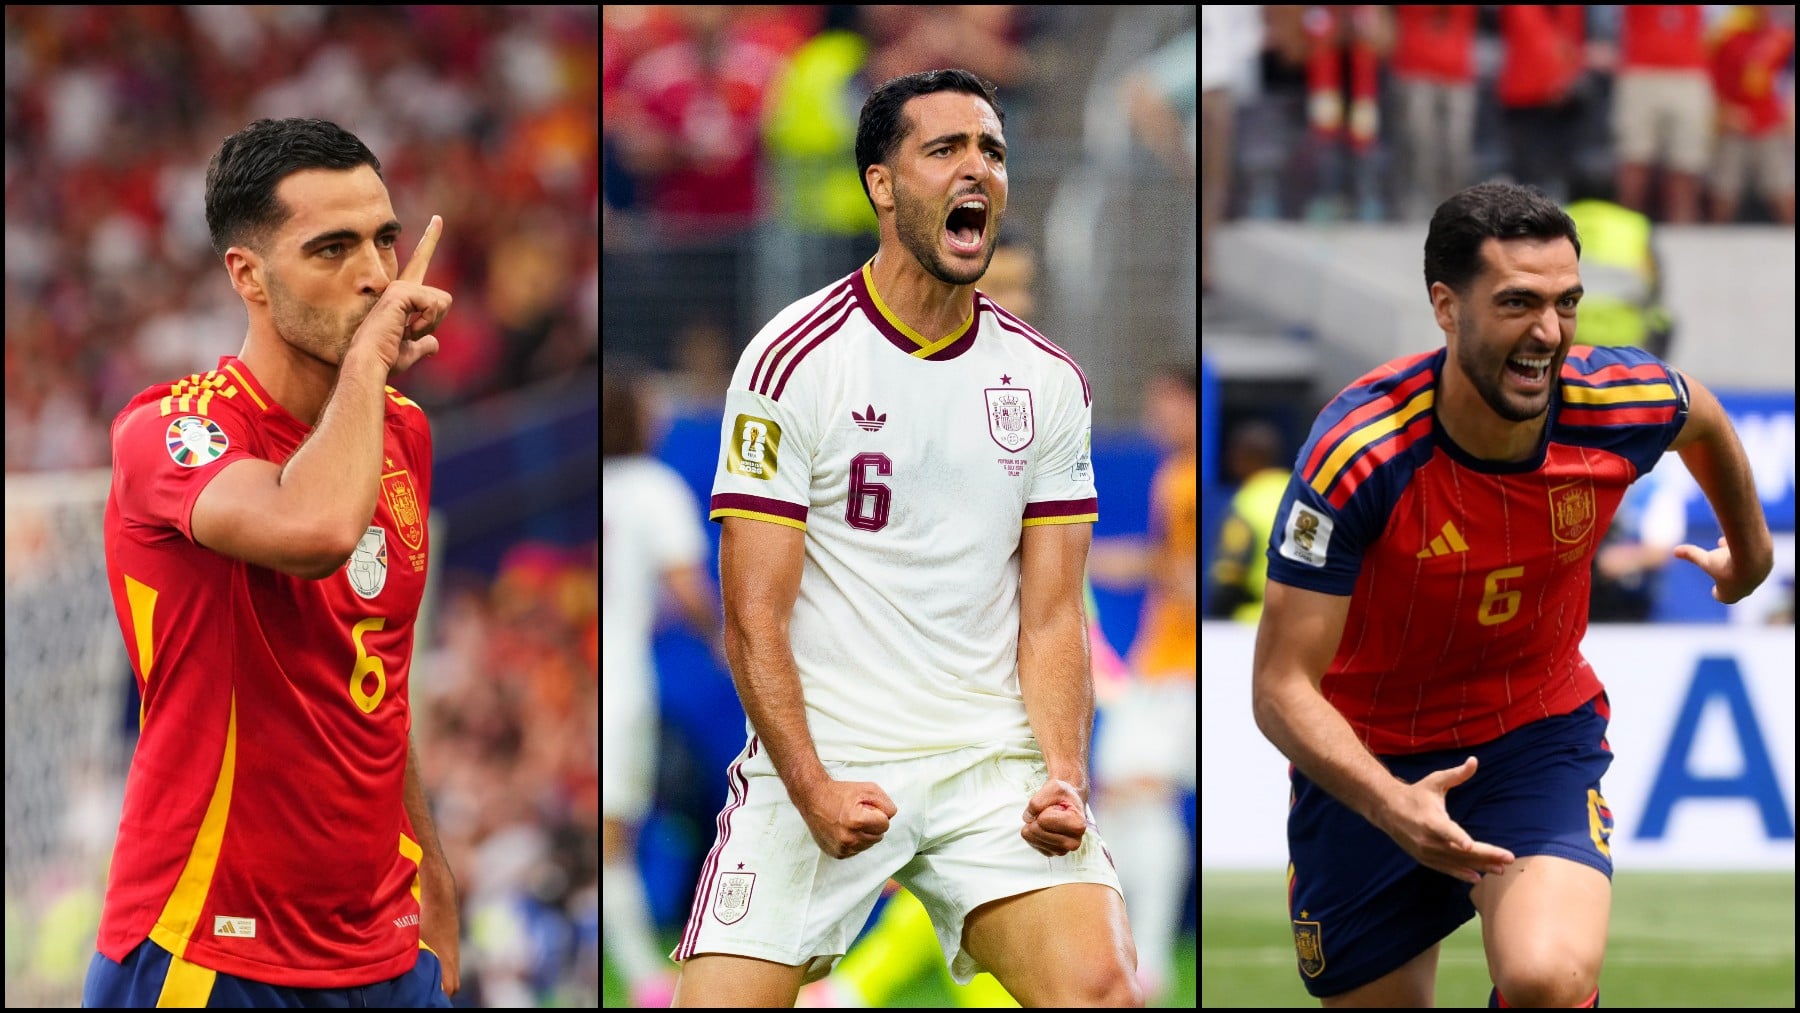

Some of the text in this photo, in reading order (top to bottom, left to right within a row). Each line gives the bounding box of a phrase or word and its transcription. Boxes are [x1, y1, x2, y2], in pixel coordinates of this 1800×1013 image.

[845, 452, 893, 532] 6
[1478, 566, 1525, 626] 6
[350, 617, 387, 714] 6
[1633, 655, 1796, 841] A
